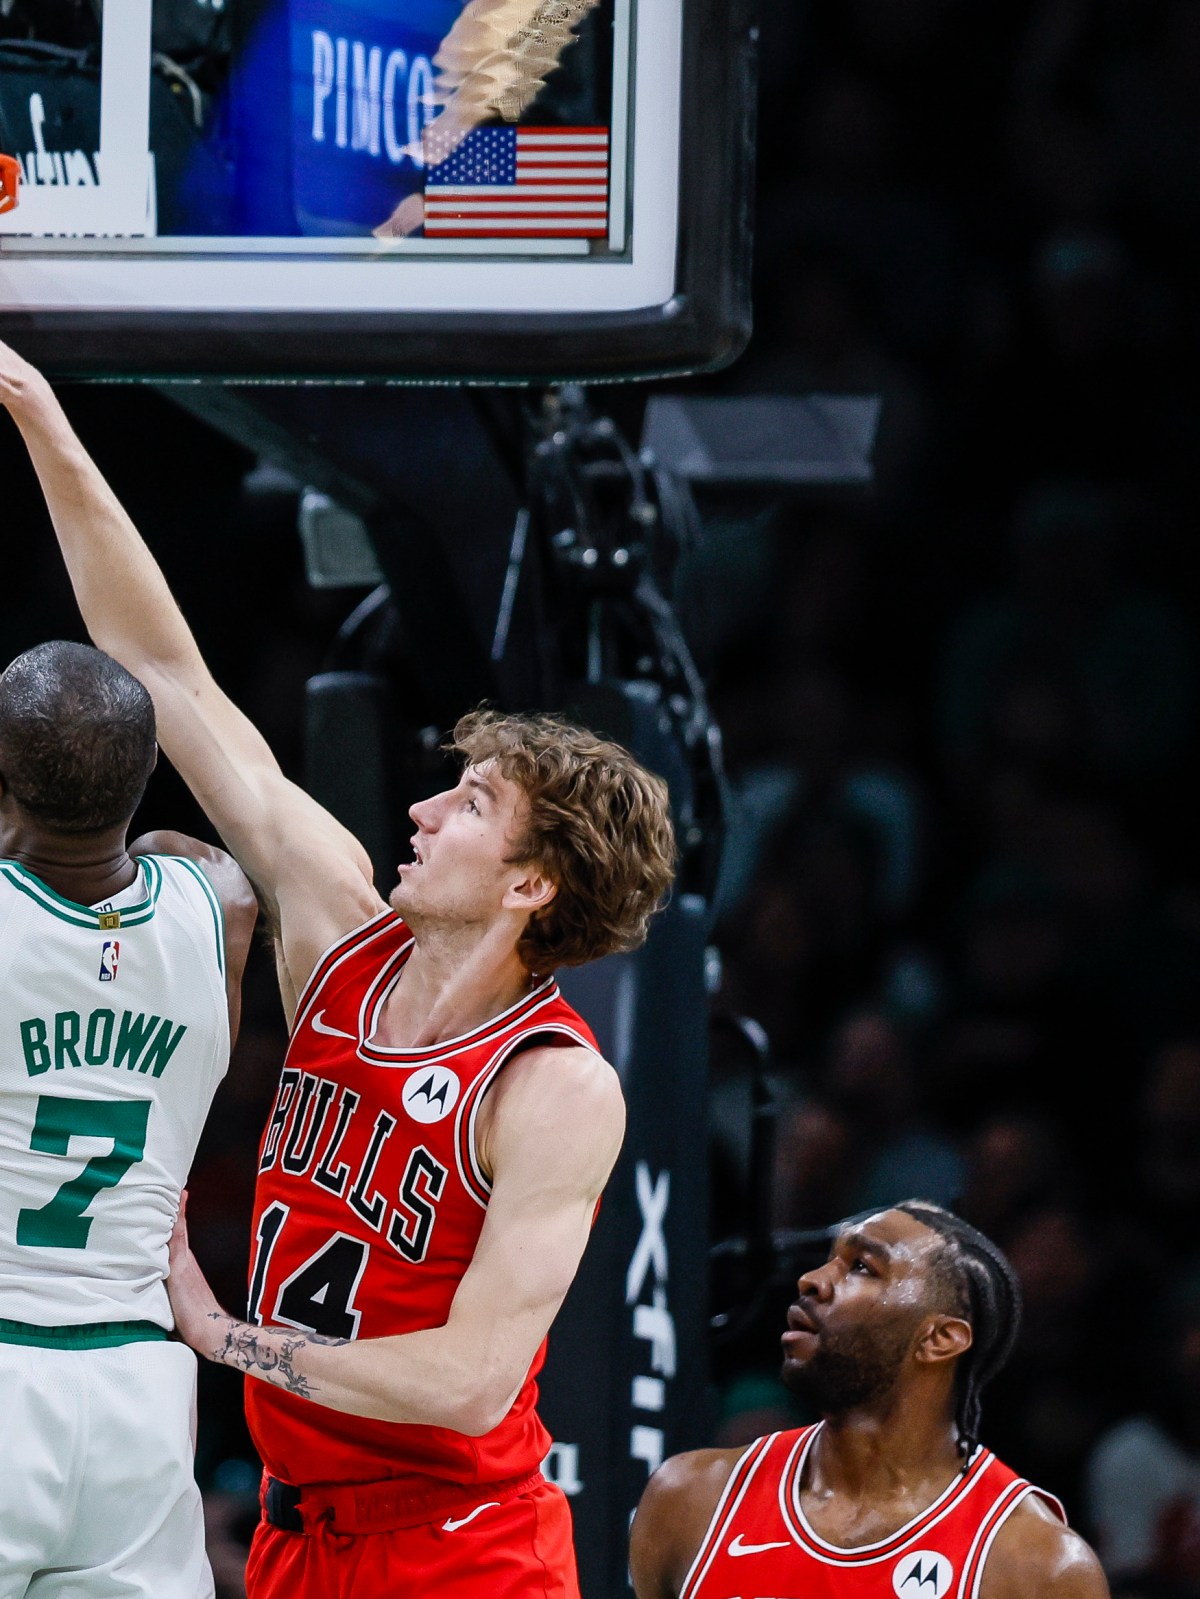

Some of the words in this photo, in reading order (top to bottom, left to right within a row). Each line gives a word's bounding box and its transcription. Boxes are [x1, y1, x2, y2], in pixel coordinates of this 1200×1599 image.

[311, 30, 434, 169] PIMCO
[20, 1008, 187, 1078] BROWN
[16, 1095, 152, 1249] 7
[258, 1068, 449, 1263] BULLS
[247, 1200, 370, 1340] 14
